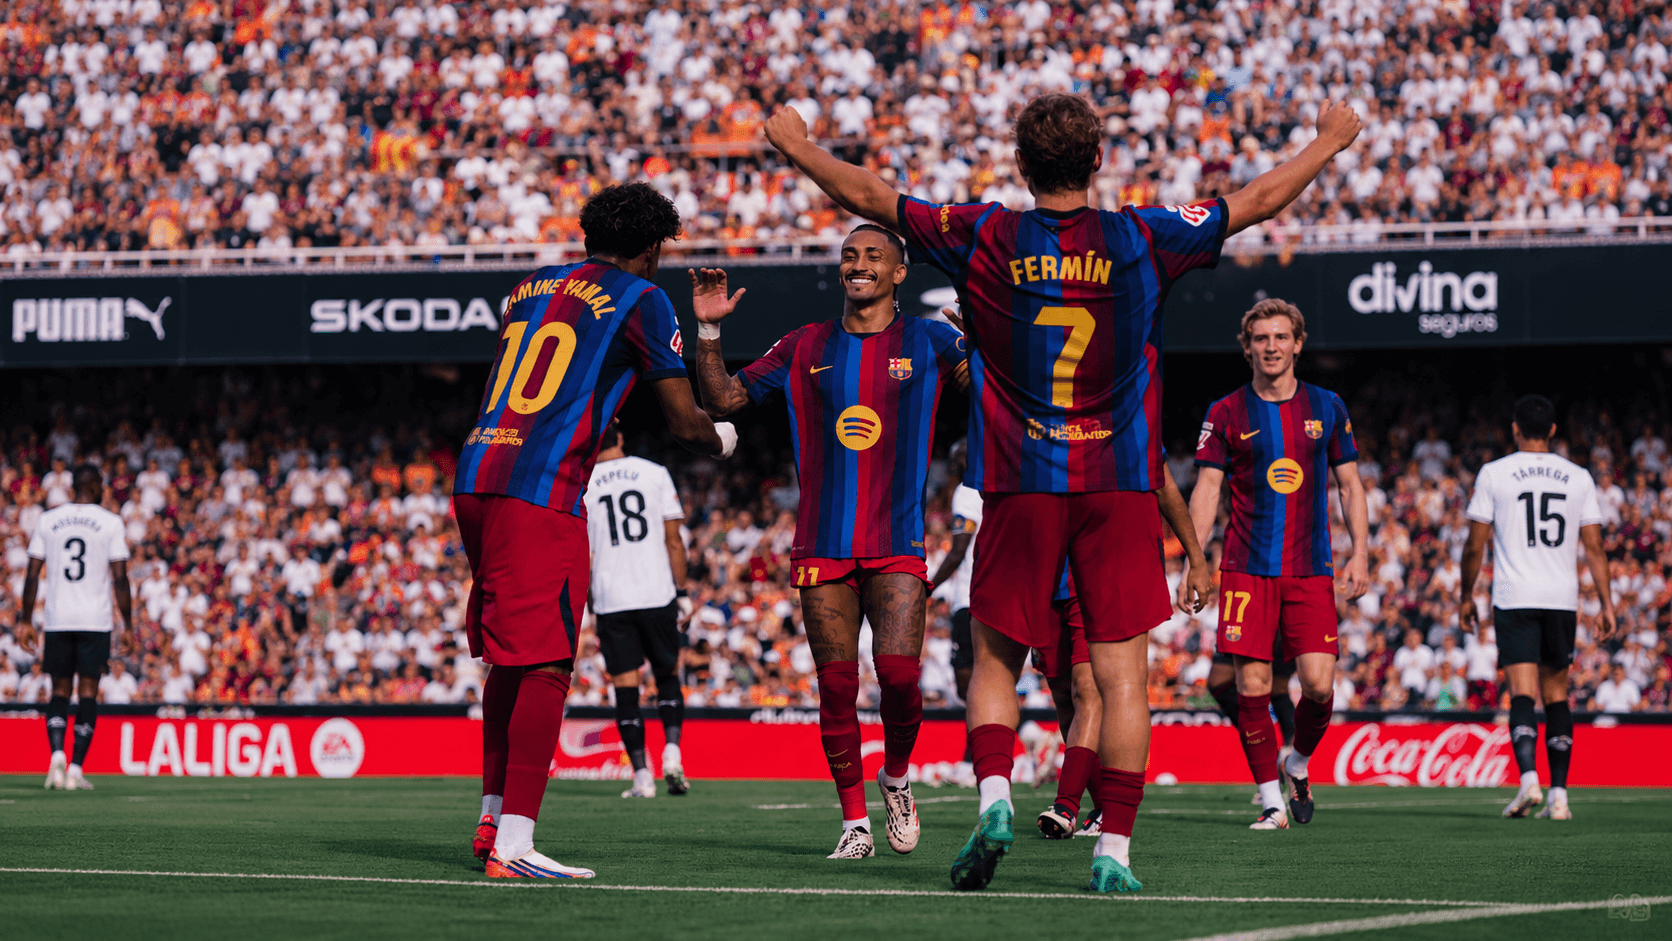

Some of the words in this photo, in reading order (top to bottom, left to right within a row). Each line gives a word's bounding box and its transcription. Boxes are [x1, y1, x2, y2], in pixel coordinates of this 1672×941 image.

[1009, 250, 1112, 285] FERMÍN
[1348, 260, 1498, 314] divina
[12, 297, 124, 342] PUMA
[310, 298, 498, 333] SKODA
[1418, 313, 1498, 339] seguros
[486, 320, 577, 416] 10
[1033, 306, 1096, 408] 7
[595, 469, 639, 487] PEPELU
[598, 490, 648, 546] 18
[1517, 491, 1567, 548] 15
[64, 536, 86, 582] 3
[796, 566, 820, 586] 11
[1222, 591, 1251, 623] 17
[119, 722, 298, 778] LALIGA
